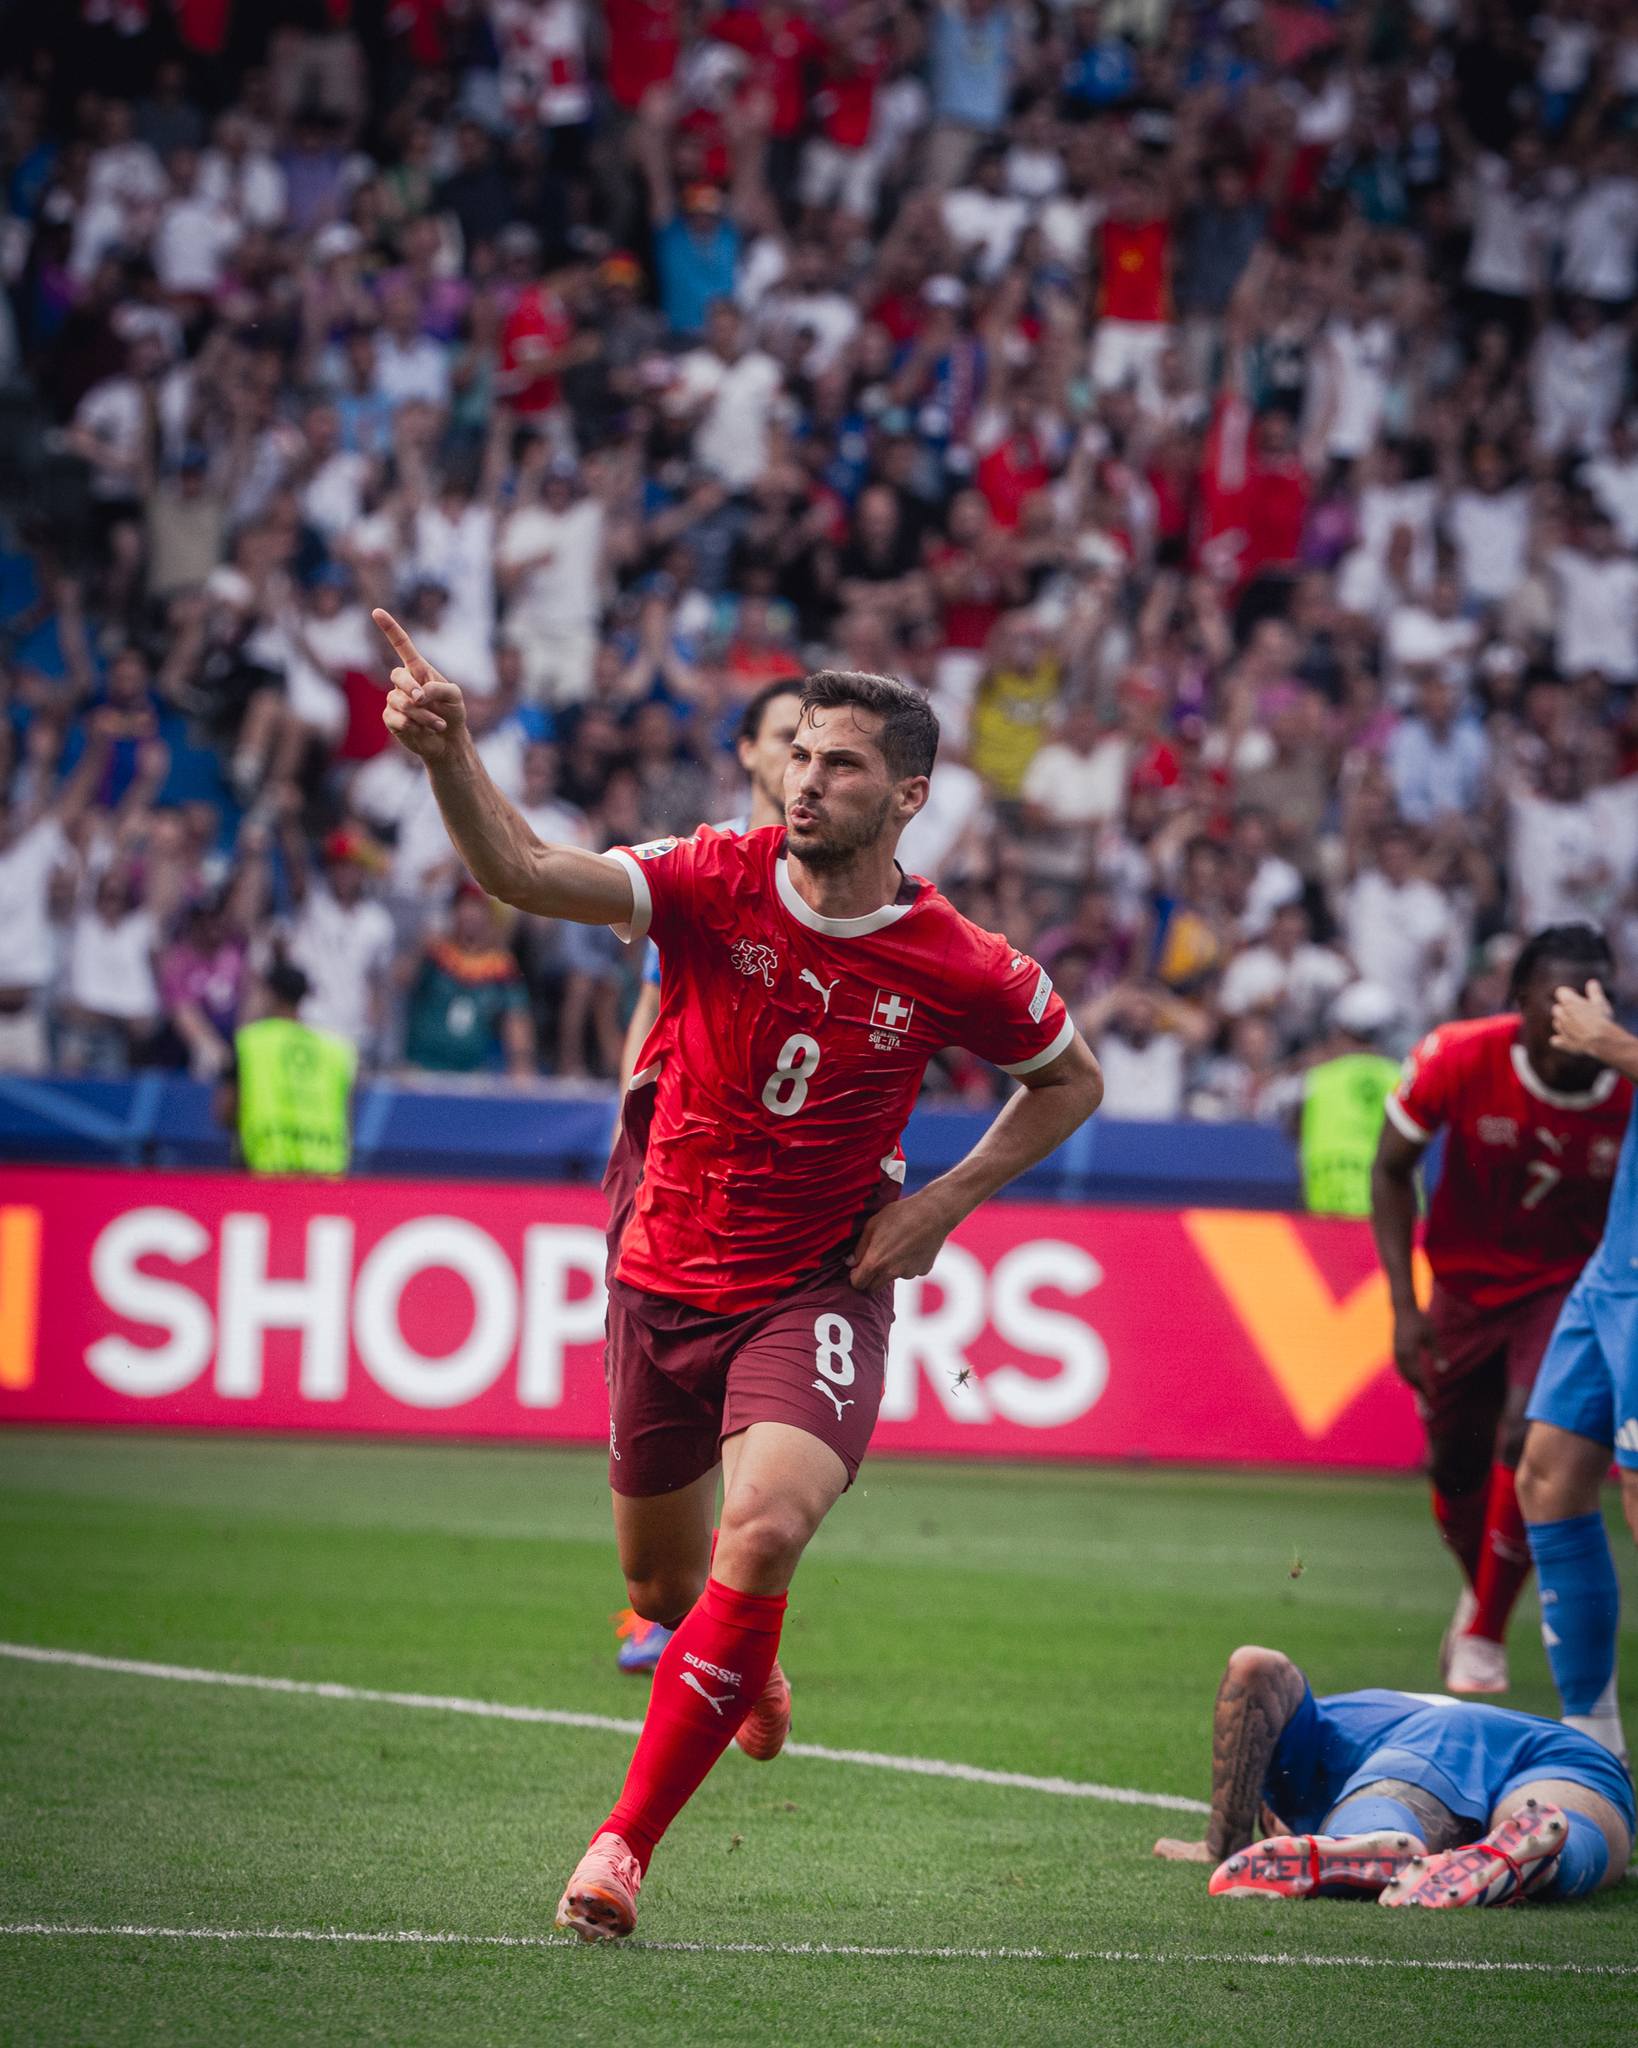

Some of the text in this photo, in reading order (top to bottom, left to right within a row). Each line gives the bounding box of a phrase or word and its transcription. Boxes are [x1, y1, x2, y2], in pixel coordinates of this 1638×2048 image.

[888, 1038, 900, 1047] ITA
[761, 1033, 821, 1116] 8
[1522, 1161, 1562, 1211] 7
[84, 1206, 1111, 1429] SHOPRS
[814, 1312, 856, 1386] 8
[682, 1652, 742, 1687] SUISSE
